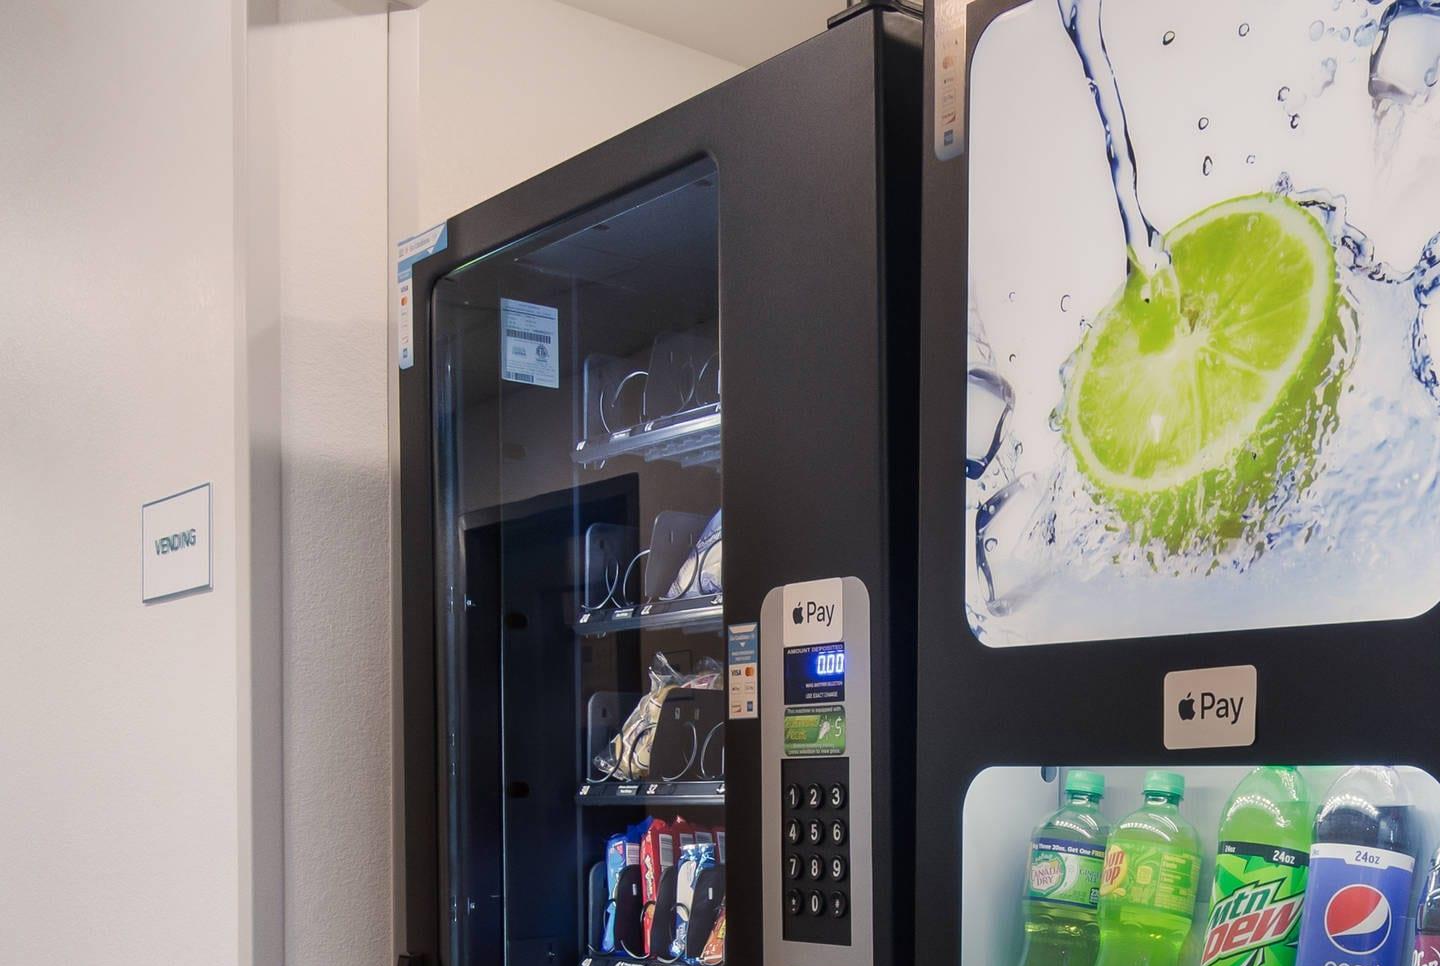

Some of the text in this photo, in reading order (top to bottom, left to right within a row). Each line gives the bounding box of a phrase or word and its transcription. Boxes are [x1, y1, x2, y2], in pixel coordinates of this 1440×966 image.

[155, 528, 197, 556] VENDING
[806, 600, 835, 626] Pay
[1201, 692, 1244, 725] Pay
[789, 788, 840, 805] 1 2 3
[789, 823, 840, 841] 4 5 6
[1272, 850, 1295, 865] 24oz
[1354, 850, 1381, 865] 24oz
[789, 859, 840, 877] 7 8 9
[811, 896, 818, 913] 0
